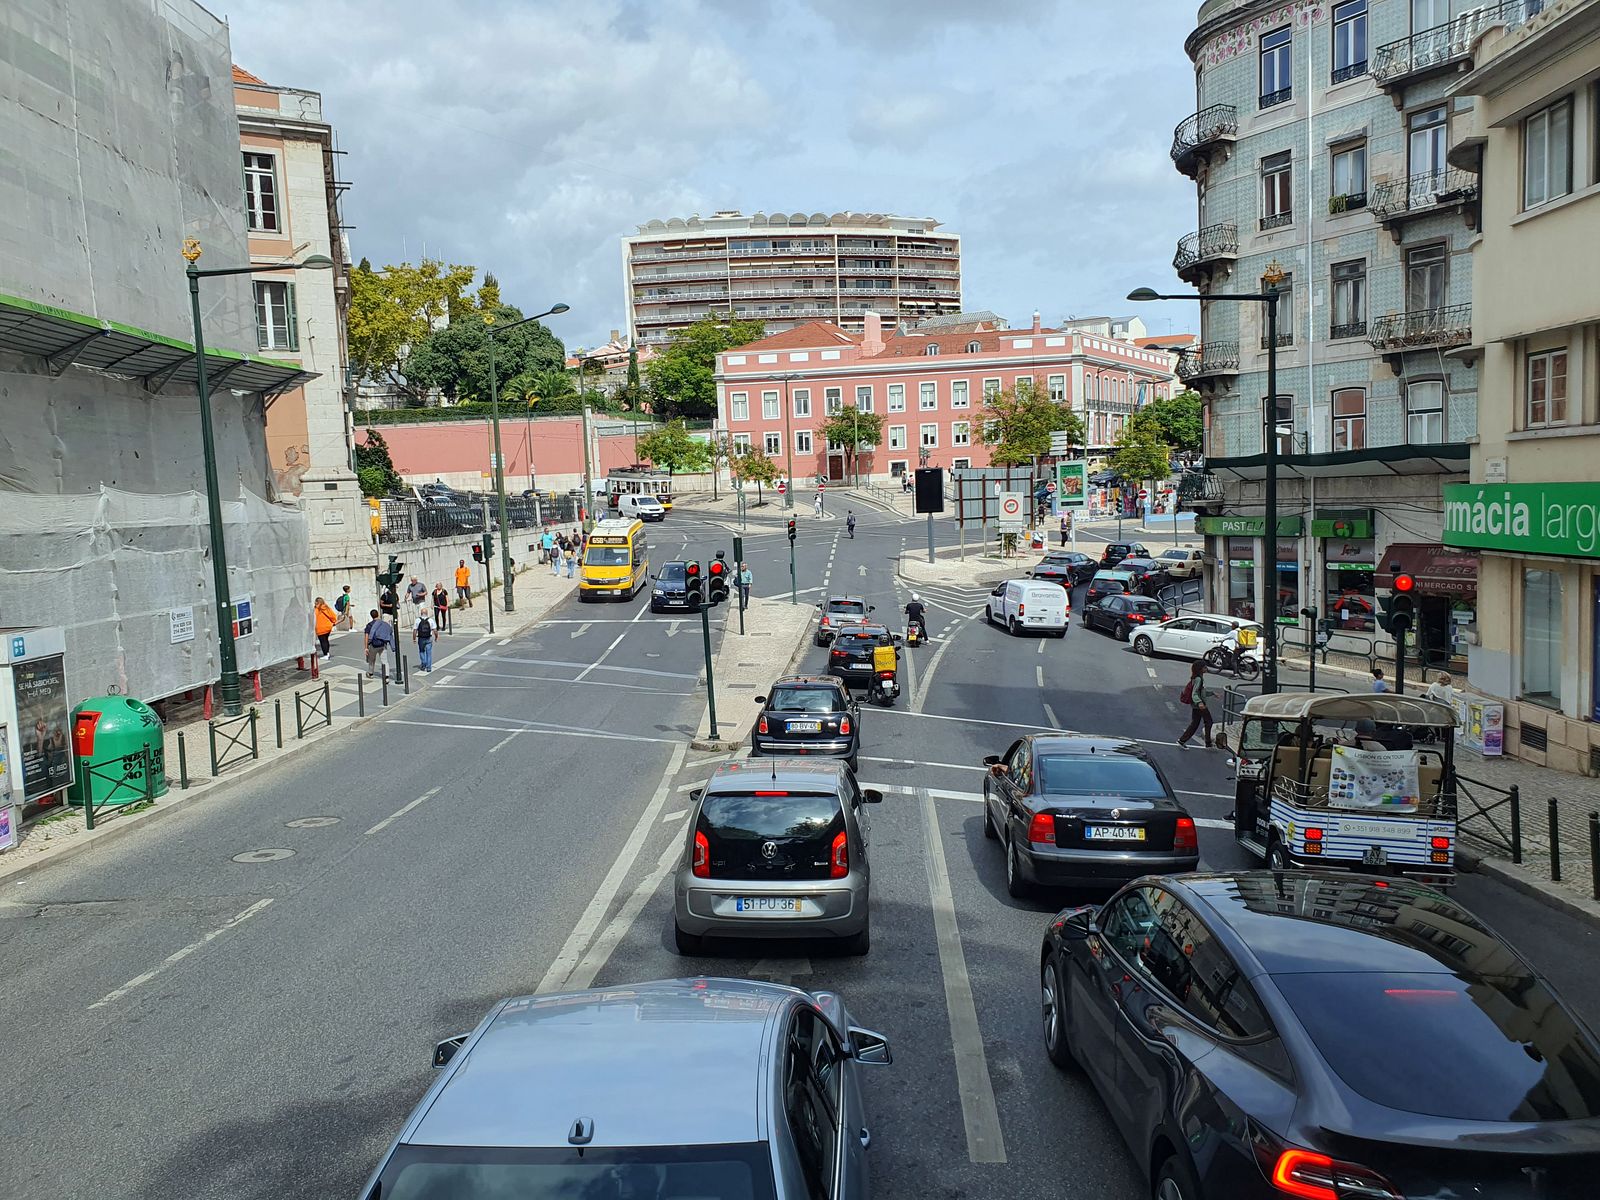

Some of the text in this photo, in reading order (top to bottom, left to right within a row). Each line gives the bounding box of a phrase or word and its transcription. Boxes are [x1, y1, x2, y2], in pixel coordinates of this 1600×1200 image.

[1444, 490, 1600, 552] rmácia larg
[1423, 565, 1477, 576] ICE CREA
[1415, 581, 1463, 591] NIMERCADO
